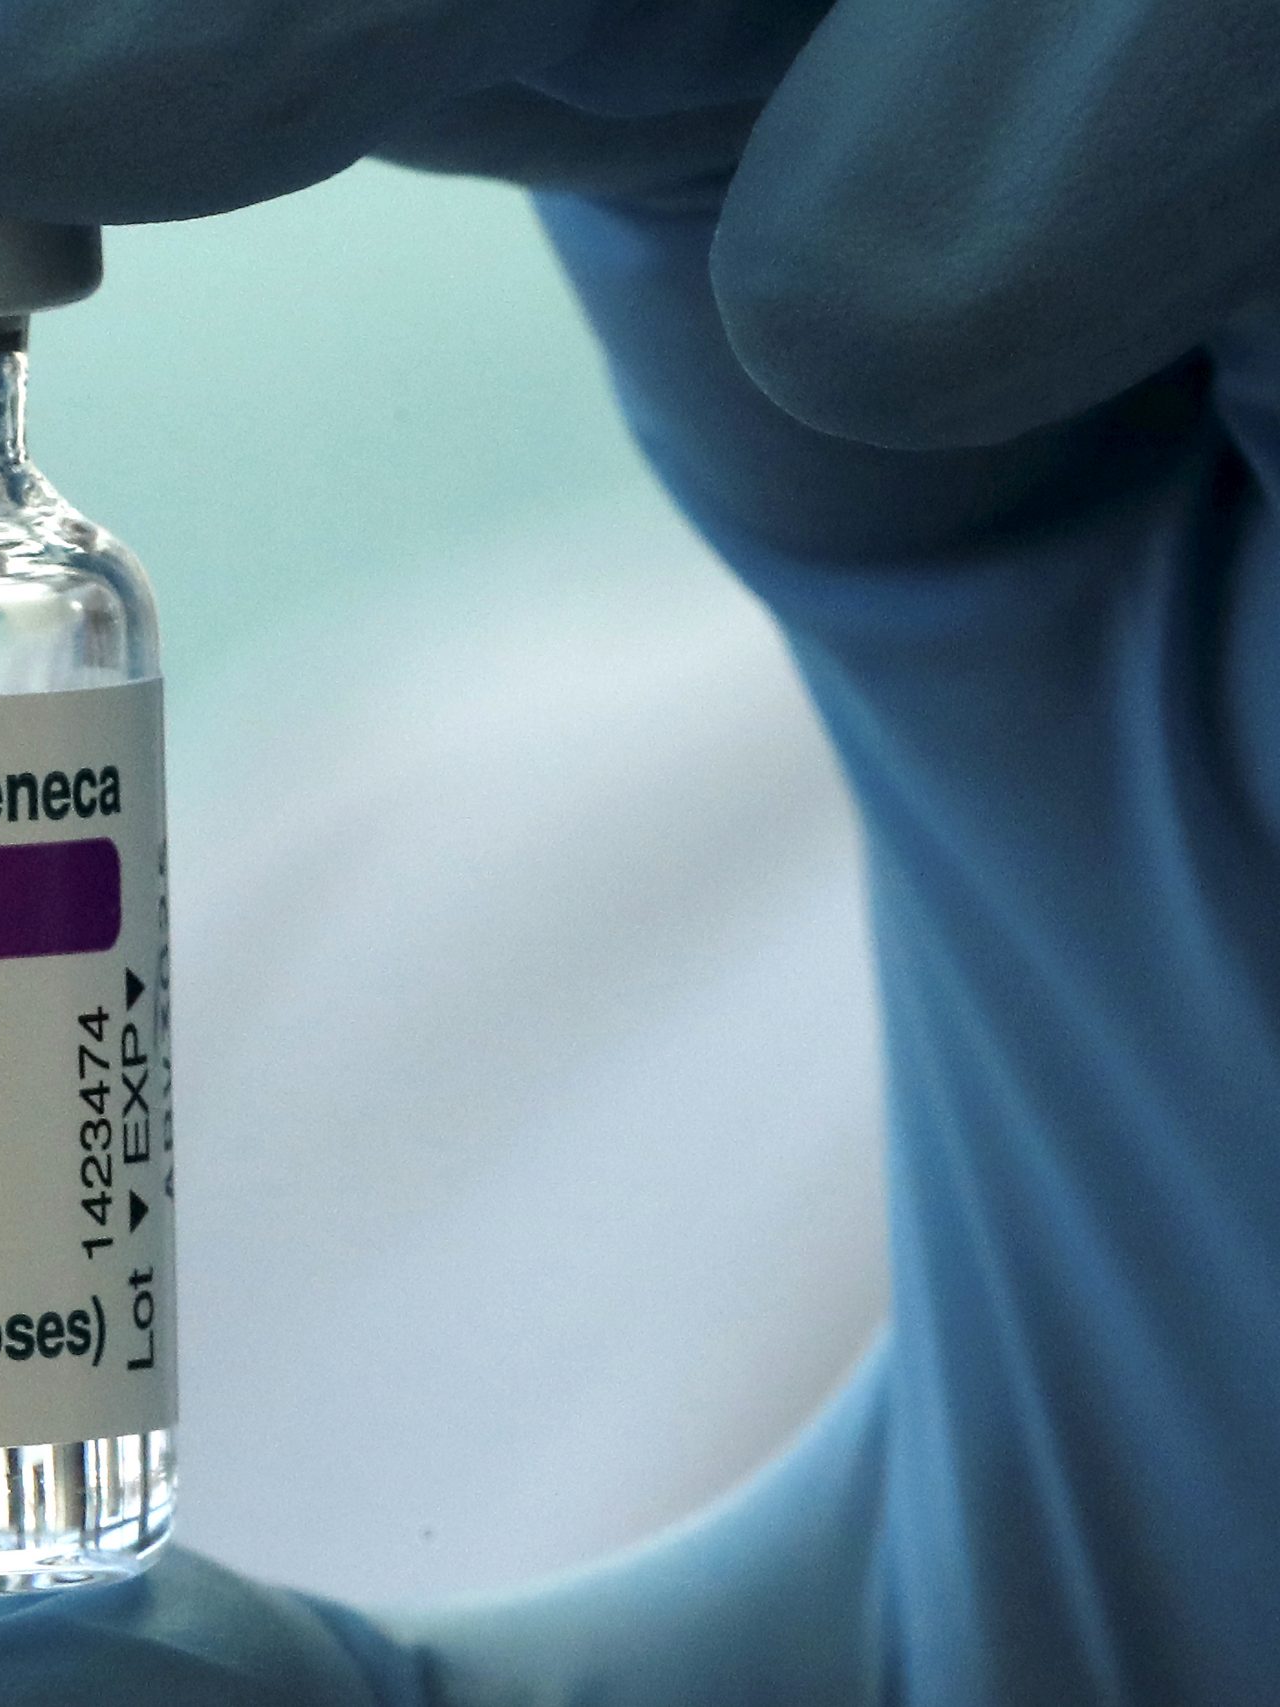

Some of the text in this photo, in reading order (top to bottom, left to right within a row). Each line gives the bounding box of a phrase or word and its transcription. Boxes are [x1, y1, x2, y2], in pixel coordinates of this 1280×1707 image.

[77, 1005, 114, 1260] 1423474
[119, 1021, 156, 1372] Lot EXP
